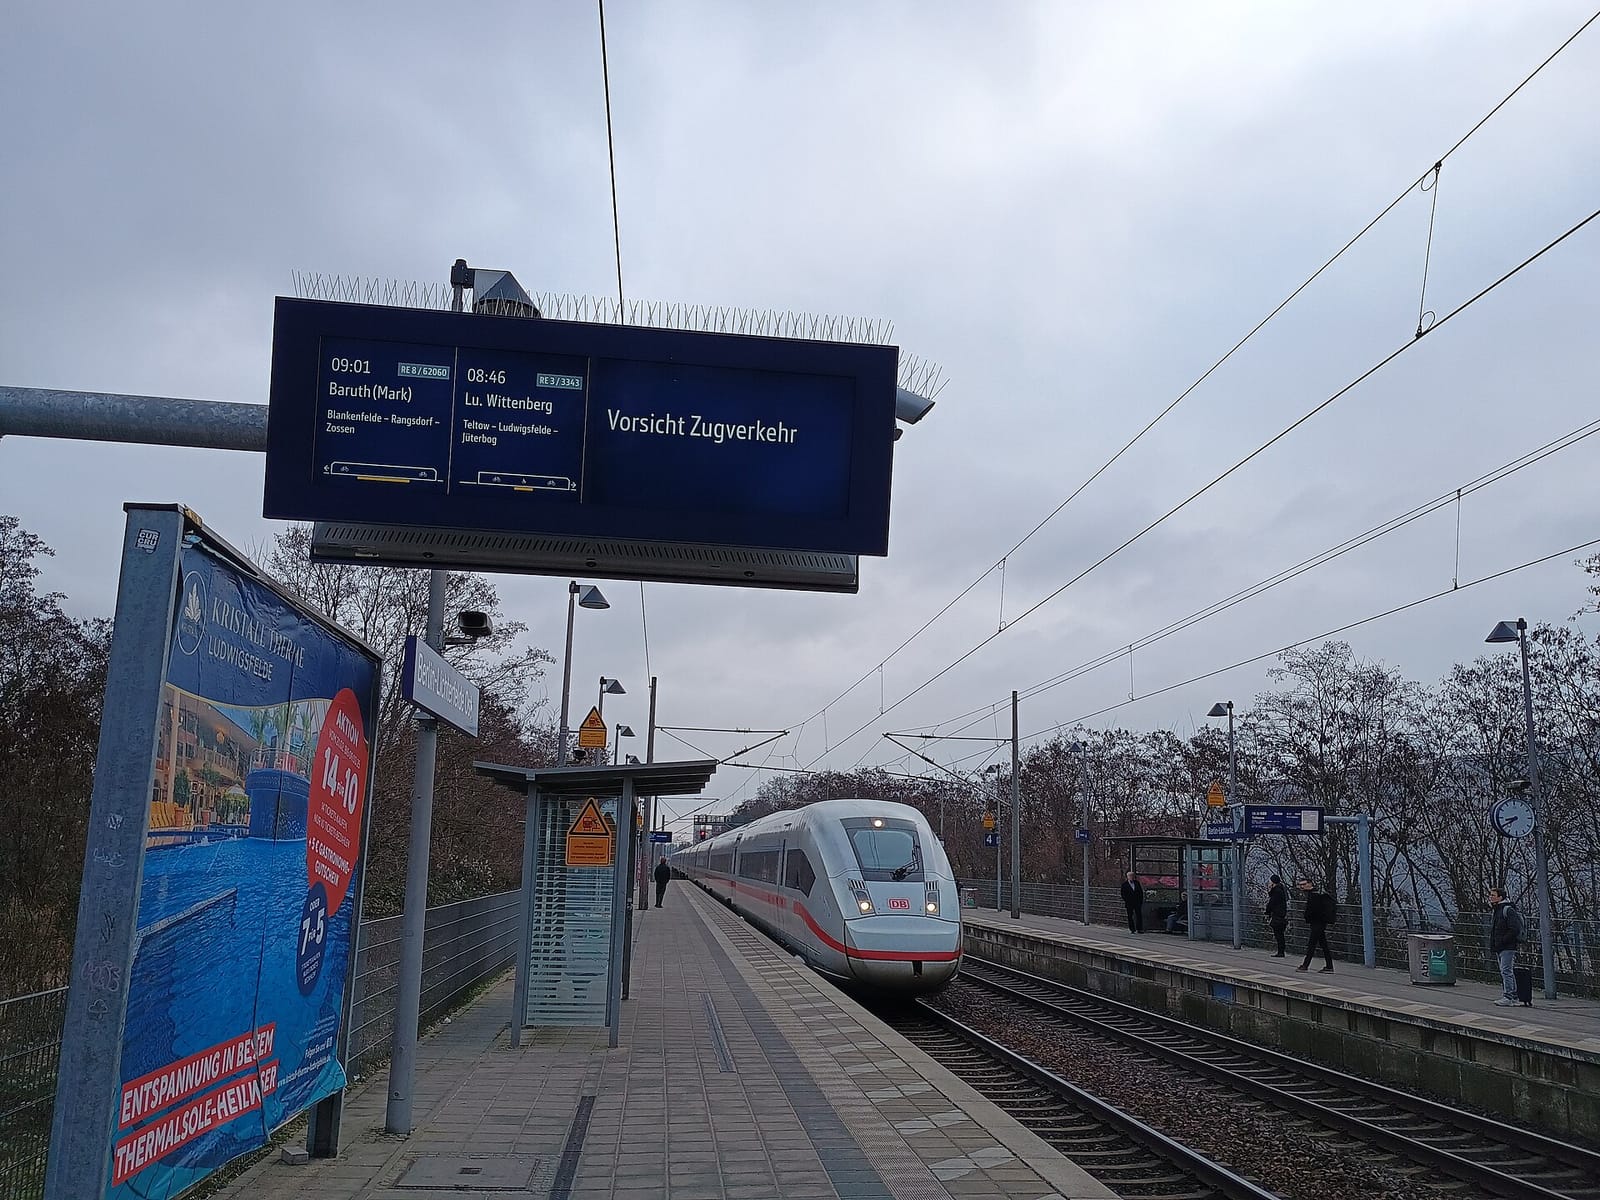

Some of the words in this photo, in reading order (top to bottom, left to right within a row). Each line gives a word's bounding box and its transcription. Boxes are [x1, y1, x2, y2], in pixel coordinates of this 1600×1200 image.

[331, 357, 371, 374] 09:01
[467, 368, 506, 384] 08:46
[465, 391, 483, 407] Lu.
[486, 393, 553, 415] Wittenberg
[326, 422, 355, 434] Zossen
[327, 409, 382, 423] Blankenfelde
[391, 414, 433, 427] Rangsdorf
[463, 419, 490, 431] Teltow
[498, 422, 552, 436] Ludwigsfelde
[607, 408, 686, 436] Vorsicht
[690, 415, 797, 444] Zugverkehr
[461, 432, 497, 446] Jüterbog
[212, 597, 265, 647] KRISTALL
[208, 636, 273, 681] LUDWIGSFELDE
[336, 709, 359, 749] AKTION
[321, 746, 339, 797] 14
[343, 768, 359, 815] 10
[986, 835, 992, 844] 4
[890, 899, 908, 909] DB
[301, 917, 310, 956] 7
[316, 907, 325, 944] 5
[121, 1051, 220, 1123] ENTSPANNUNG
[222, 1045, 235, 1074] IN
